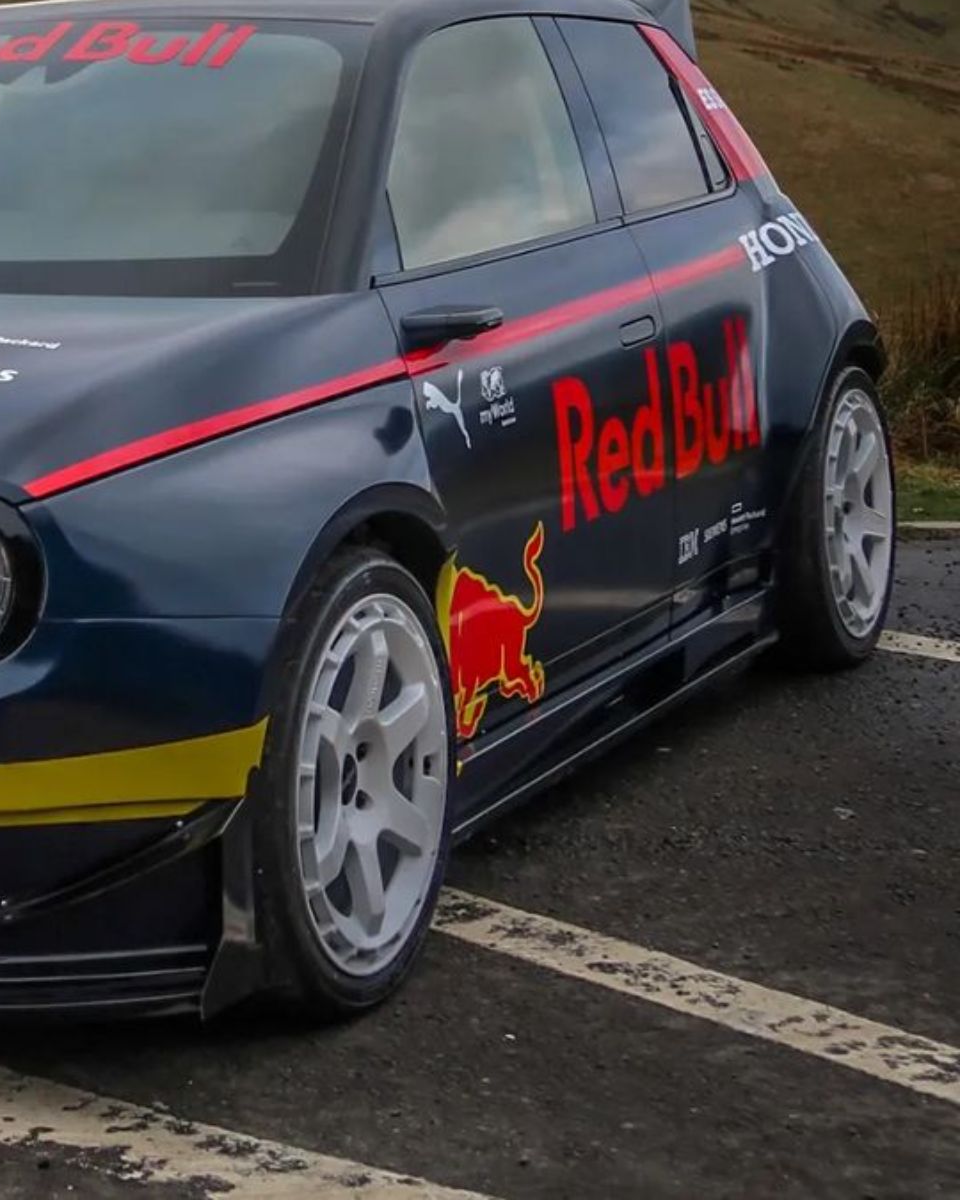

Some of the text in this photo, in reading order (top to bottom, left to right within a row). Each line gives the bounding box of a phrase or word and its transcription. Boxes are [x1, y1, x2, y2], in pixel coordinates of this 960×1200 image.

[64, 21, 257, 69] Bull
[552, 317, 762, 533] Red Bull
